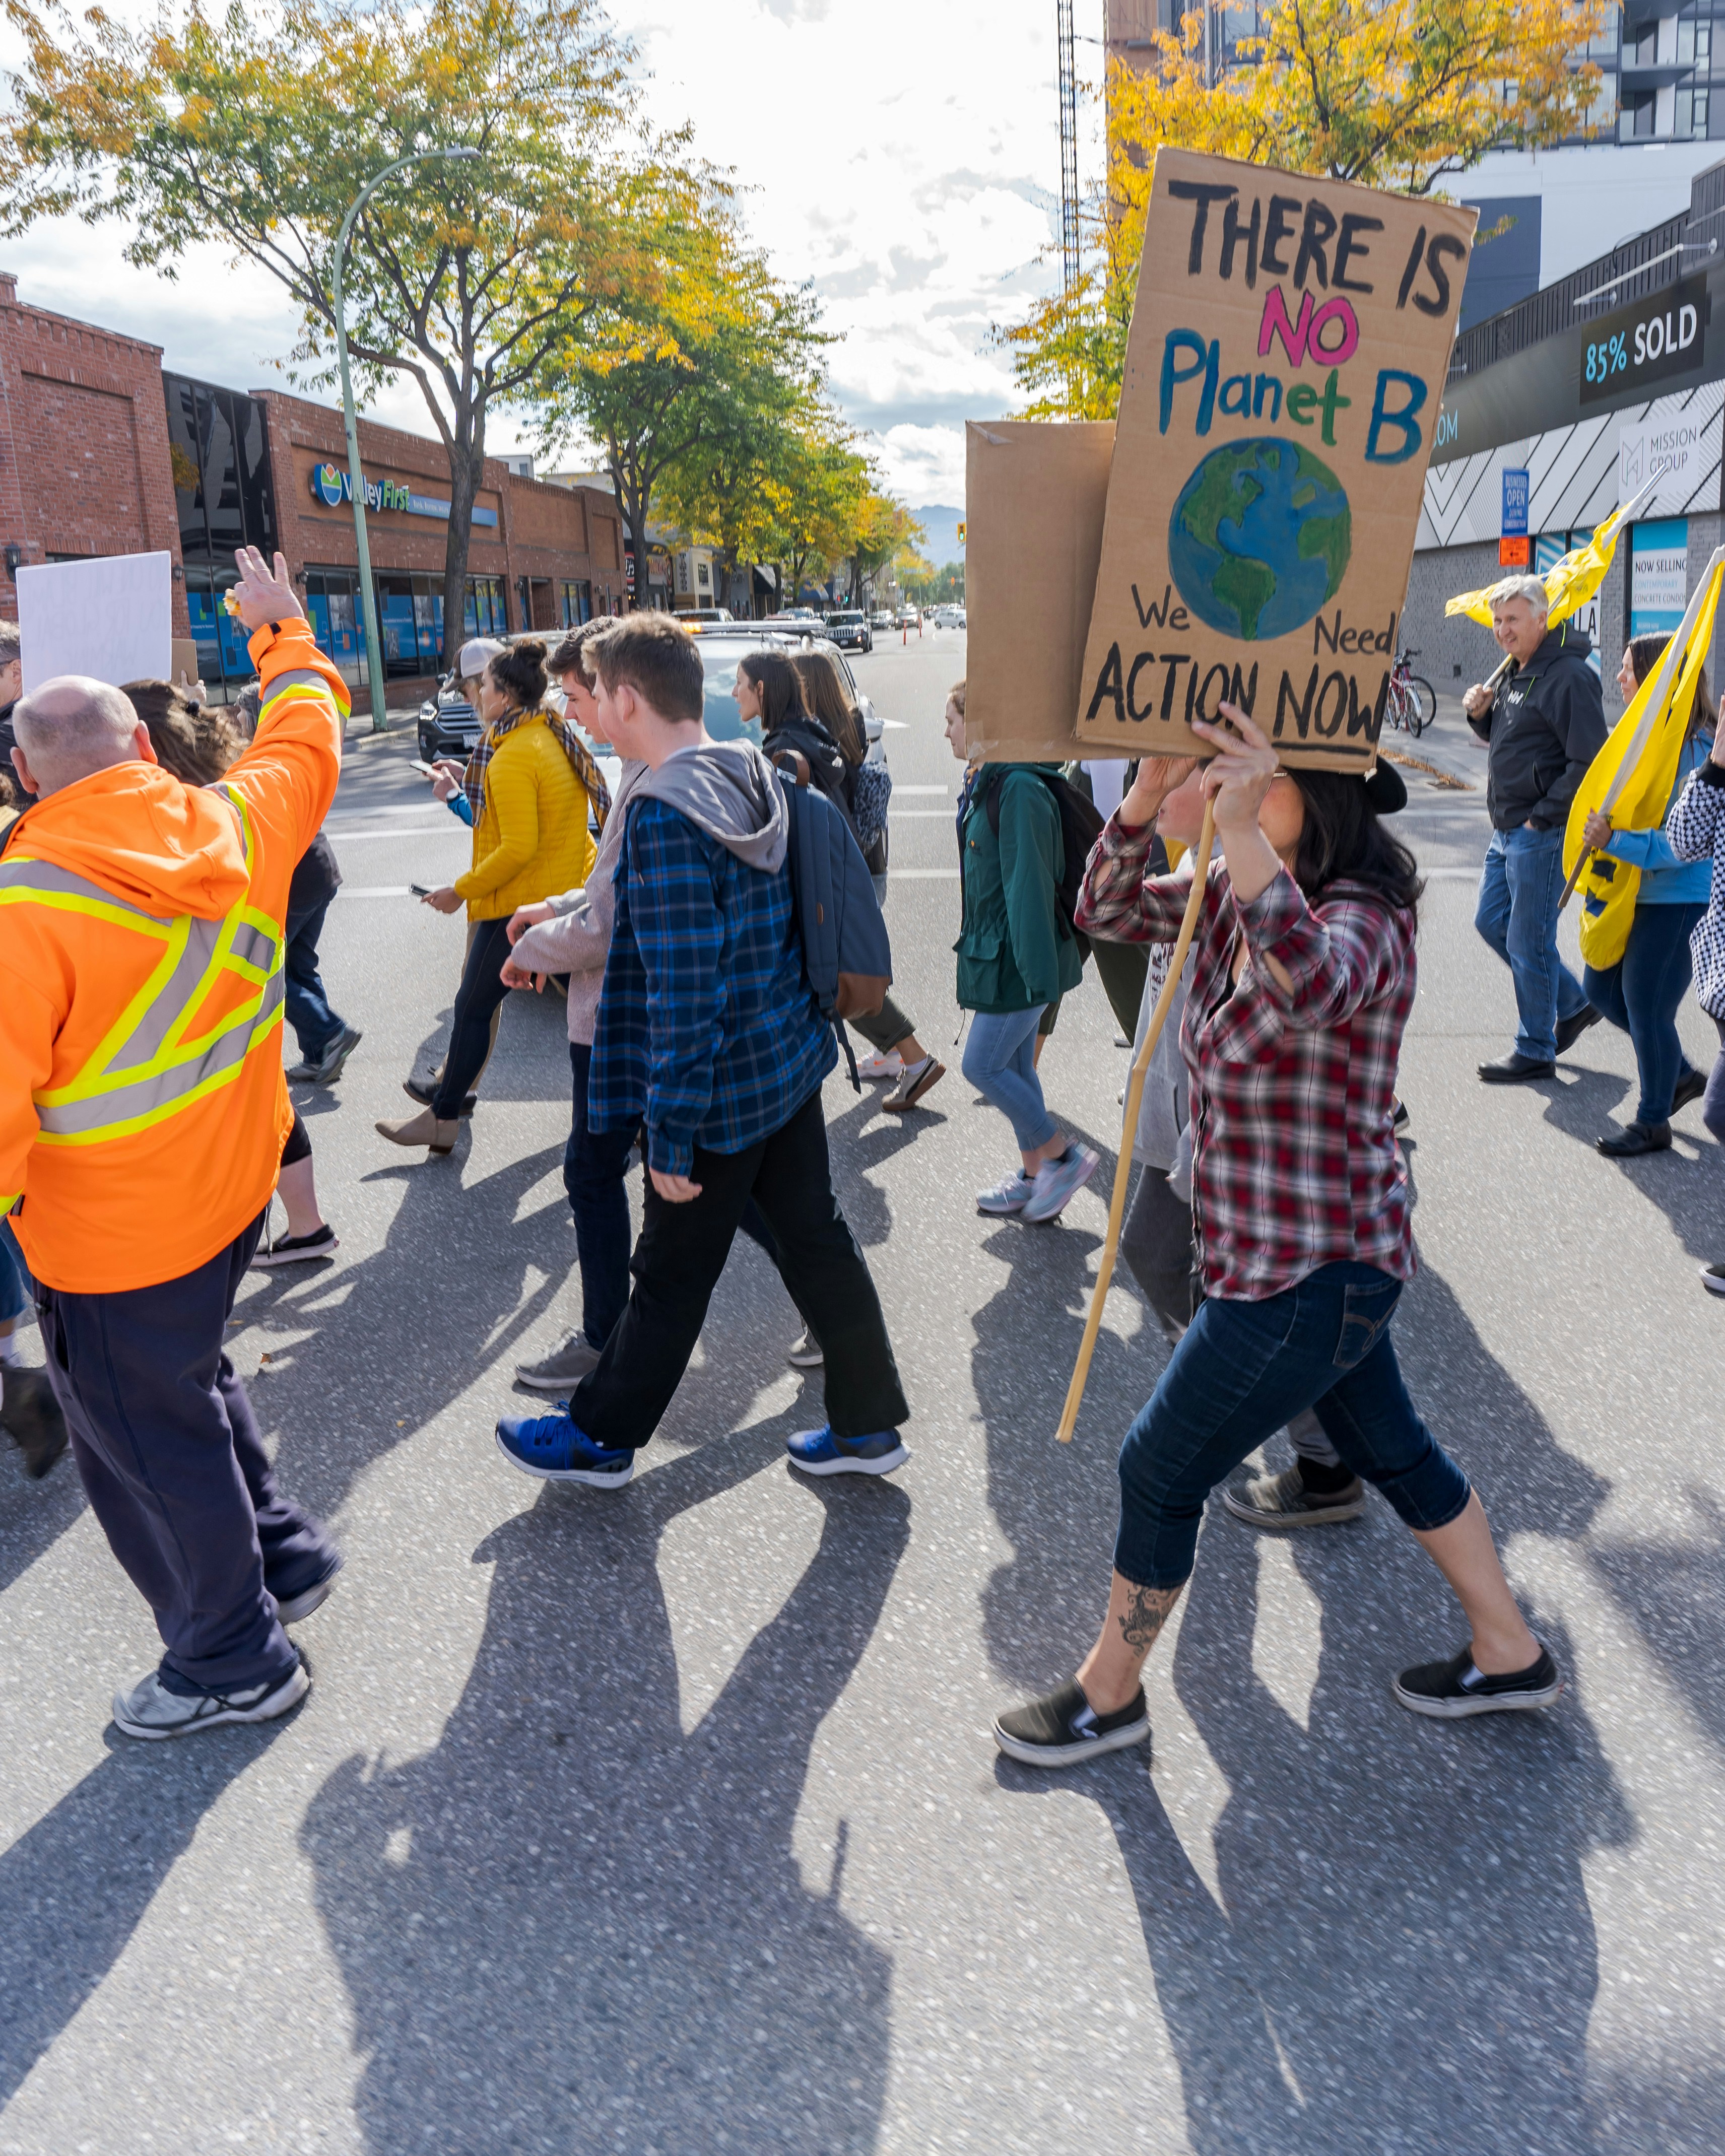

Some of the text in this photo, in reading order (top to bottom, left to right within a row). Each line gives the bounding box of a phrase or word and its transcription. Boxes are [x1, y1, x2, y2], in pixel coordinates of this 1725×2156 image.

[1168, 180, 1466, 318] THERE IS
[1256, 283, 1360, 369] NO
[1585, 303, 1697, 384] 85% SOLD
[1159, 327, 1428, 465] Planet B
[1433, 408, 1458, 447] OM
[1650, 425, 1697, 454] MISSION
[1649, 450, 1688, 477] GROUP
[383, 479, 410, 511] First
[1505, 474, 1527, 489] BUSINESSES
[1507, 488, 1525, 507] OPEN
[1504, 519, 1527, 529] CONSTRUCTION
[1509, 508, 1522, 519] DURING
[1635, 560, 1654, 574] NOW
[1634, 592, 1662, 605] CONCRETE
[1635, 579, 1678, 590] CONTEMPORARY
[1132, 583, 1190, 632] We
[1313, 609, 1395, 656] Need
[1085, 641, 1391, 743] ACTION NOW
